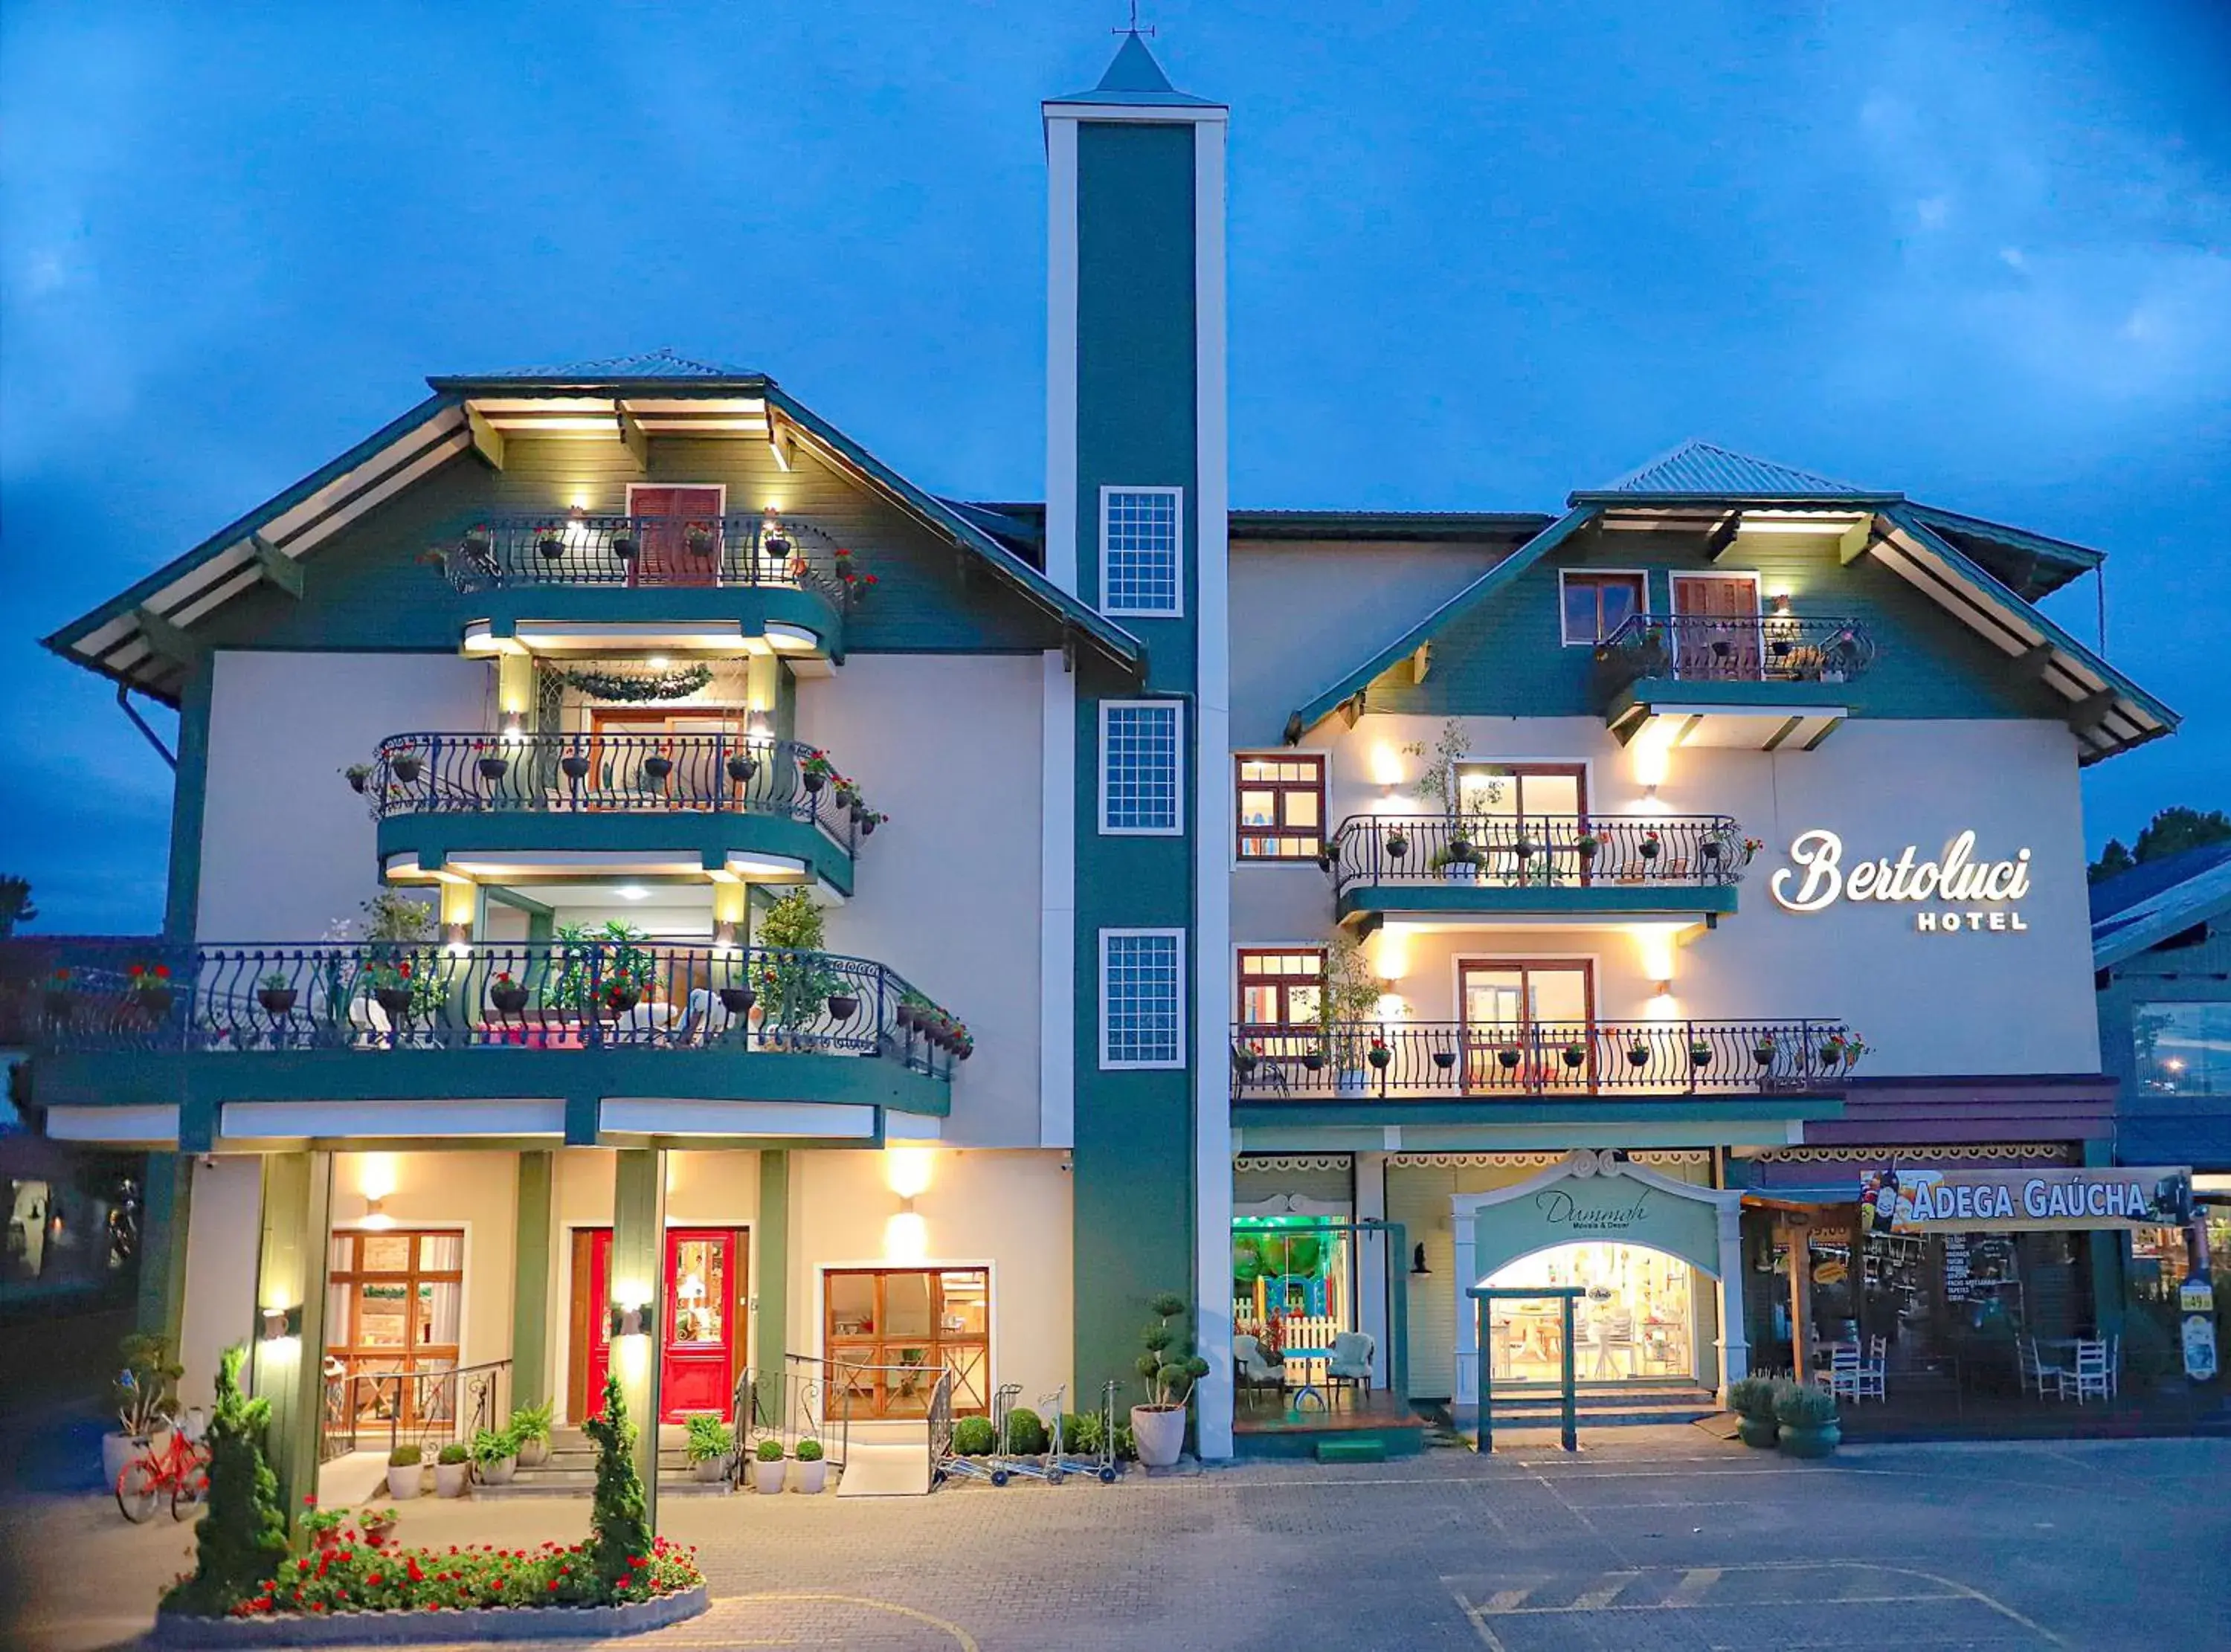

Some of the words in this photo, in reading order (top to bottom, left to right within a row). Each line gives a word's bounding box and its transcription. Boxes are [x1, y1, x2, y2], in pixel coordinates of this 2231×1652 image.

[1771, 829, 2031, 911] Bertoluci
[1917, 912, 2028, 931] HOTEL
[1911, 1179, 2014, 1219] ADEGA
[2024, 1174, 2147, 1219] GAÚCHA
